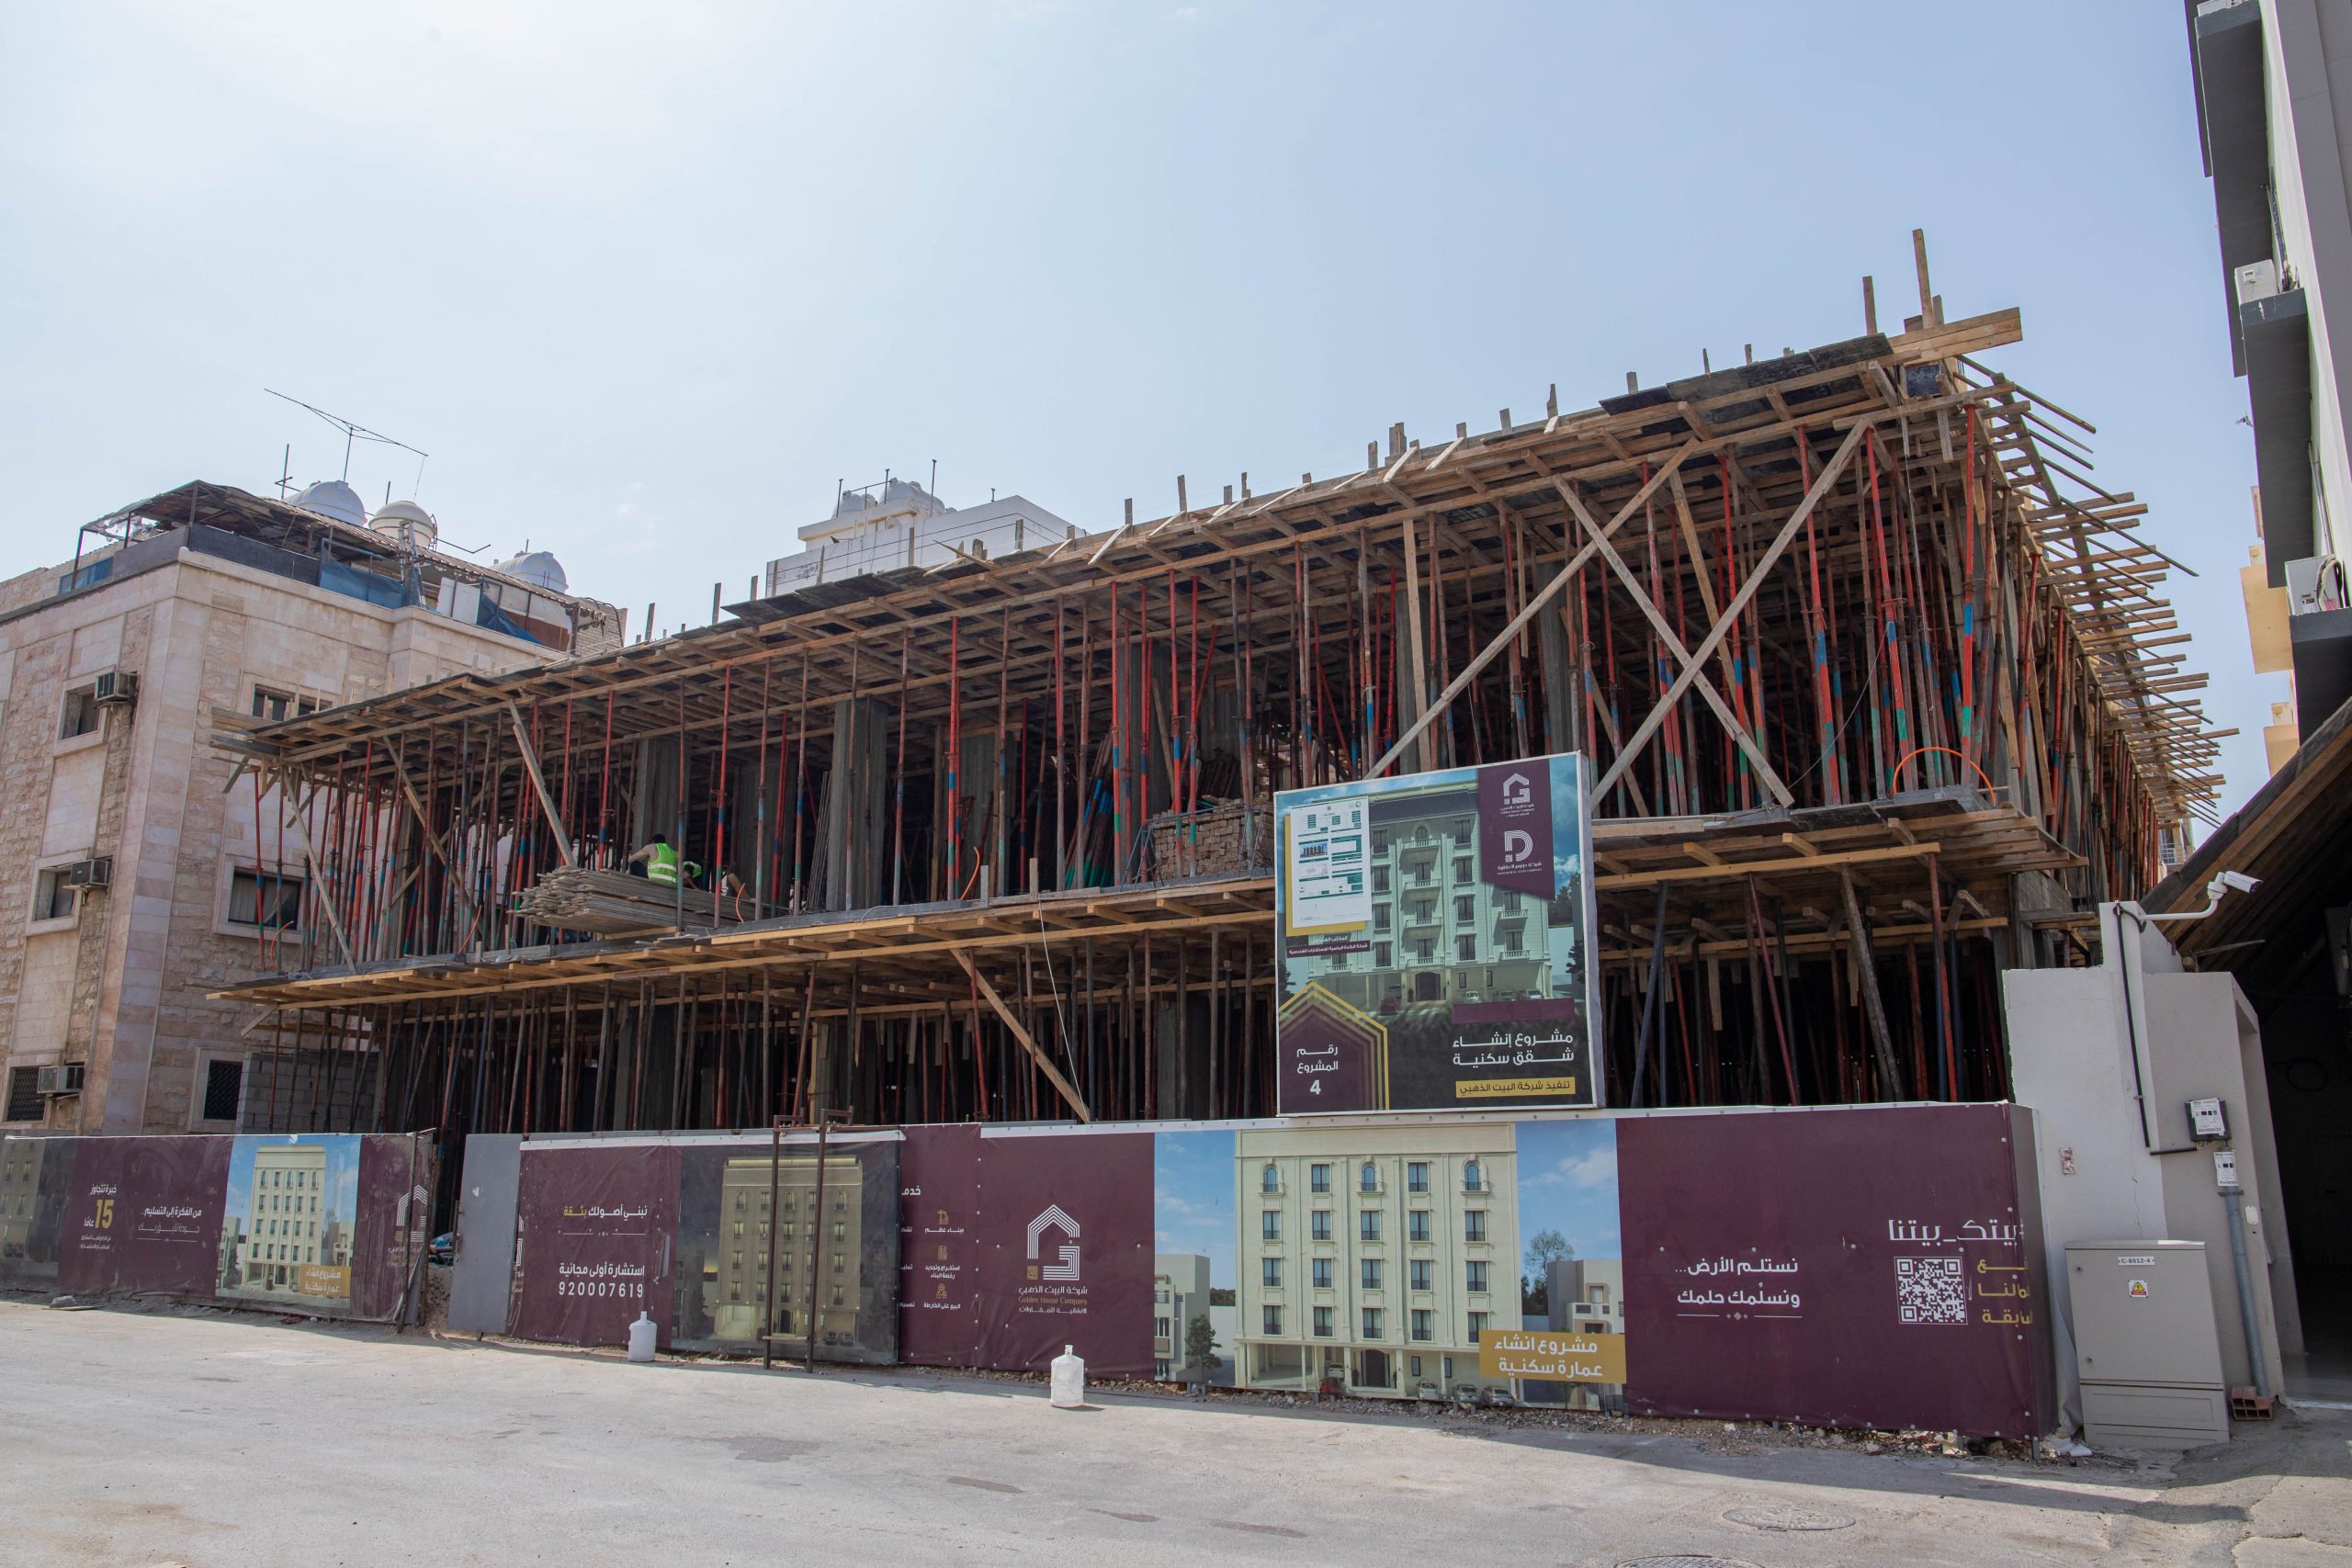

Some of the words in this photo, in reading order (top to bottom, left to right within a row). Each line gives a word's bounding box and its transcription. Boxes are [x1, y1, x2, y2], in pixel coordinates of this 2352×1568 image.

[1452, 1031, 1512, 1048] إنشاء
[1514, 1028, 1574, 1047] مشروع
[1296, 1043, 1339, 1058] رقم
[1512, 1046, 1575, 1066] شقق
[1296, 1059, 1339, 1074] المشروع
[1453, 1053, 1510, 1068] سكنية
[1309, 1079, 1321, 1095] 4
[1459, 1084, 1491, 1096] الذهبي
[1492, 1082, 1516, 1093] البيت
[1517, 1080, 1544, 1091] شركة
[1545, 1080, 1570, 1092] تنفيذ
[95, 1199, 115, 1229] 15
[175, 1205, 193, 1218] الفكرة
[192, 1209, 202, 1219] من
[563, 1204, 587, 1219] بثقة
[588, 1203, 623, 1219] أصولك
[623, 1204, 648, 1222] نبني
[320, 1268, 342, 1280] مشروع
[559, 1262, 588, 1278] مجانية
[589, 1260, 607, 1278] أولى
[607, 1262, 646, 1279] استشارة
[1736, 1258, 1798, 1276] نستلم
[305, 1280, 324, 1292] سكنية
[559, 1280, 644, 1298] 920007619
[1018, 1285, 1044, 1296] الذهبي
[1044, 1285, 1065, 1296] البيت
[1066, 1285, 1088, 1296] شركة
[1018, 1296, 1039, 1304] Golden
[1040, 1296, 1058, 1304] House
[1060, 1296, 1088, 1306] Company
[1677, 1290, 1725, 1304] حلمك
[1494, 1334, 1535, 1351] انشاء
[1537, 1335, 1598, 1356] مشروع
[1498, 1357, 1555, 1377] سكنية
[1557, 1359, 1603, 1379] عمارة
